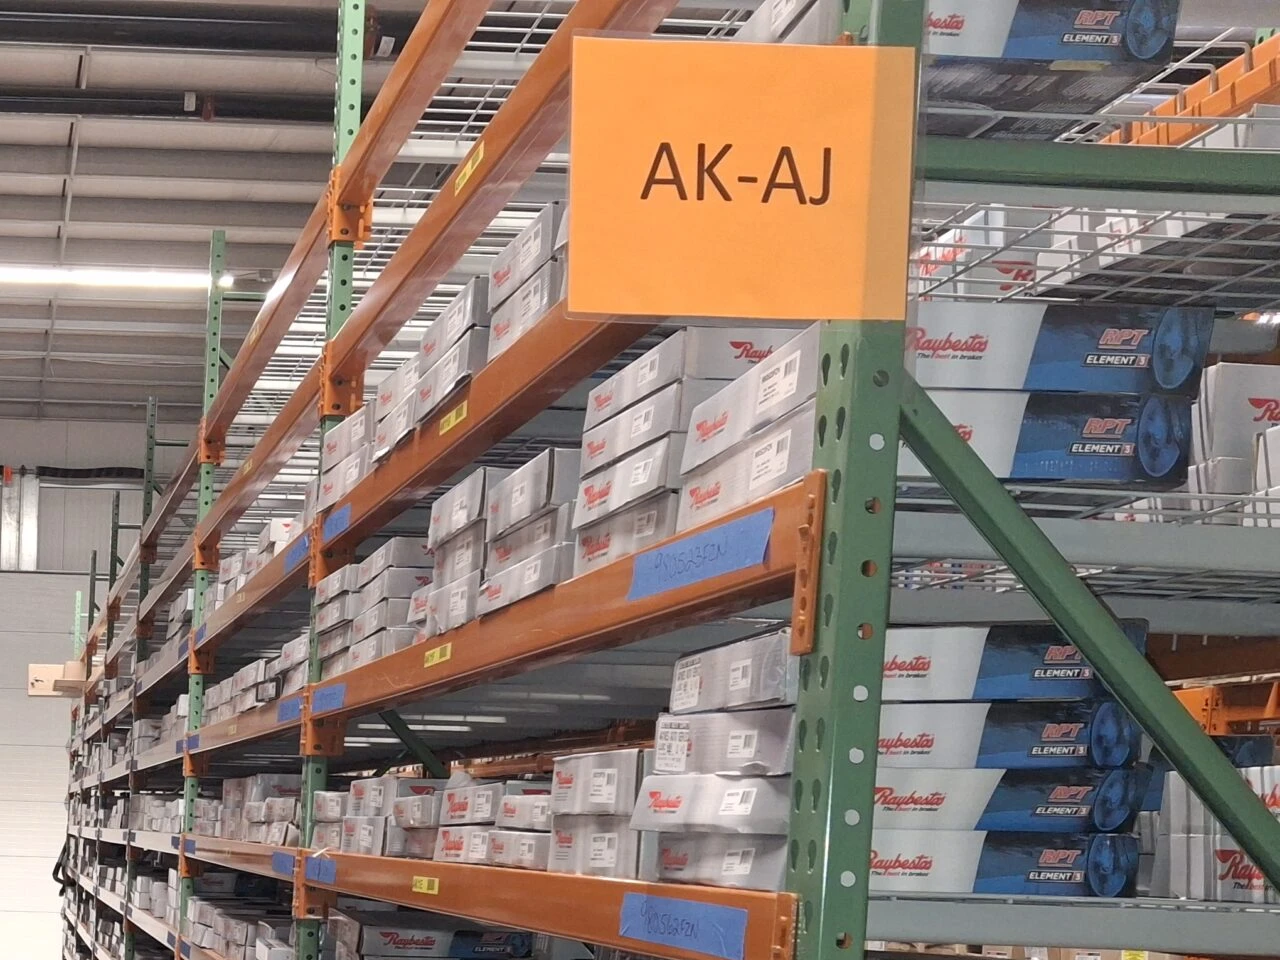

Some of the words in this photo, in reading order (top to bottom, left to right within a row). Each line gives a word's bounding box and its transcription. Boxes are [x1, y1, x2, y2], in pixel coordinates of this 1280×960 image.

[1074, 10, 1121, 26] RPT
[1062, 33, 1109, 44] ELEMENT
[1111, 34, 1120, 44] 3
[640, 141, 832, 206] AK-AJ
[1099, 328, 1150, 346] RPT
[1086, 354, 1136, 366] ELEMENT
[1137, 355, 1147, 366] 3
[1083, 417, 1132, 435] RPT
[1071, 443, 1120, 455] ELEMENT
[1122, 444, 1132, 455] 3
[1034, 668, 1080, 678] ELEMENT
[1082, 669, 1091, 679] 3
[1042, 723, 1084, 739] RPT
[878, 732, 935, 758] aybestos
[1031, 745, 1077, 755] ELEMENT
[1078, 746, 1086, 756] 3
[874, 787, 947, 812] Raybestos
[1049, 786, 1093, 801] RPT
[1035, 806, 1078, 815] ELEMENT
[1039, 849, 1083, 864] RPT
[1028, 871, 1073, 881] ELEMENT
[1074, 871, 1083, 881] 3
